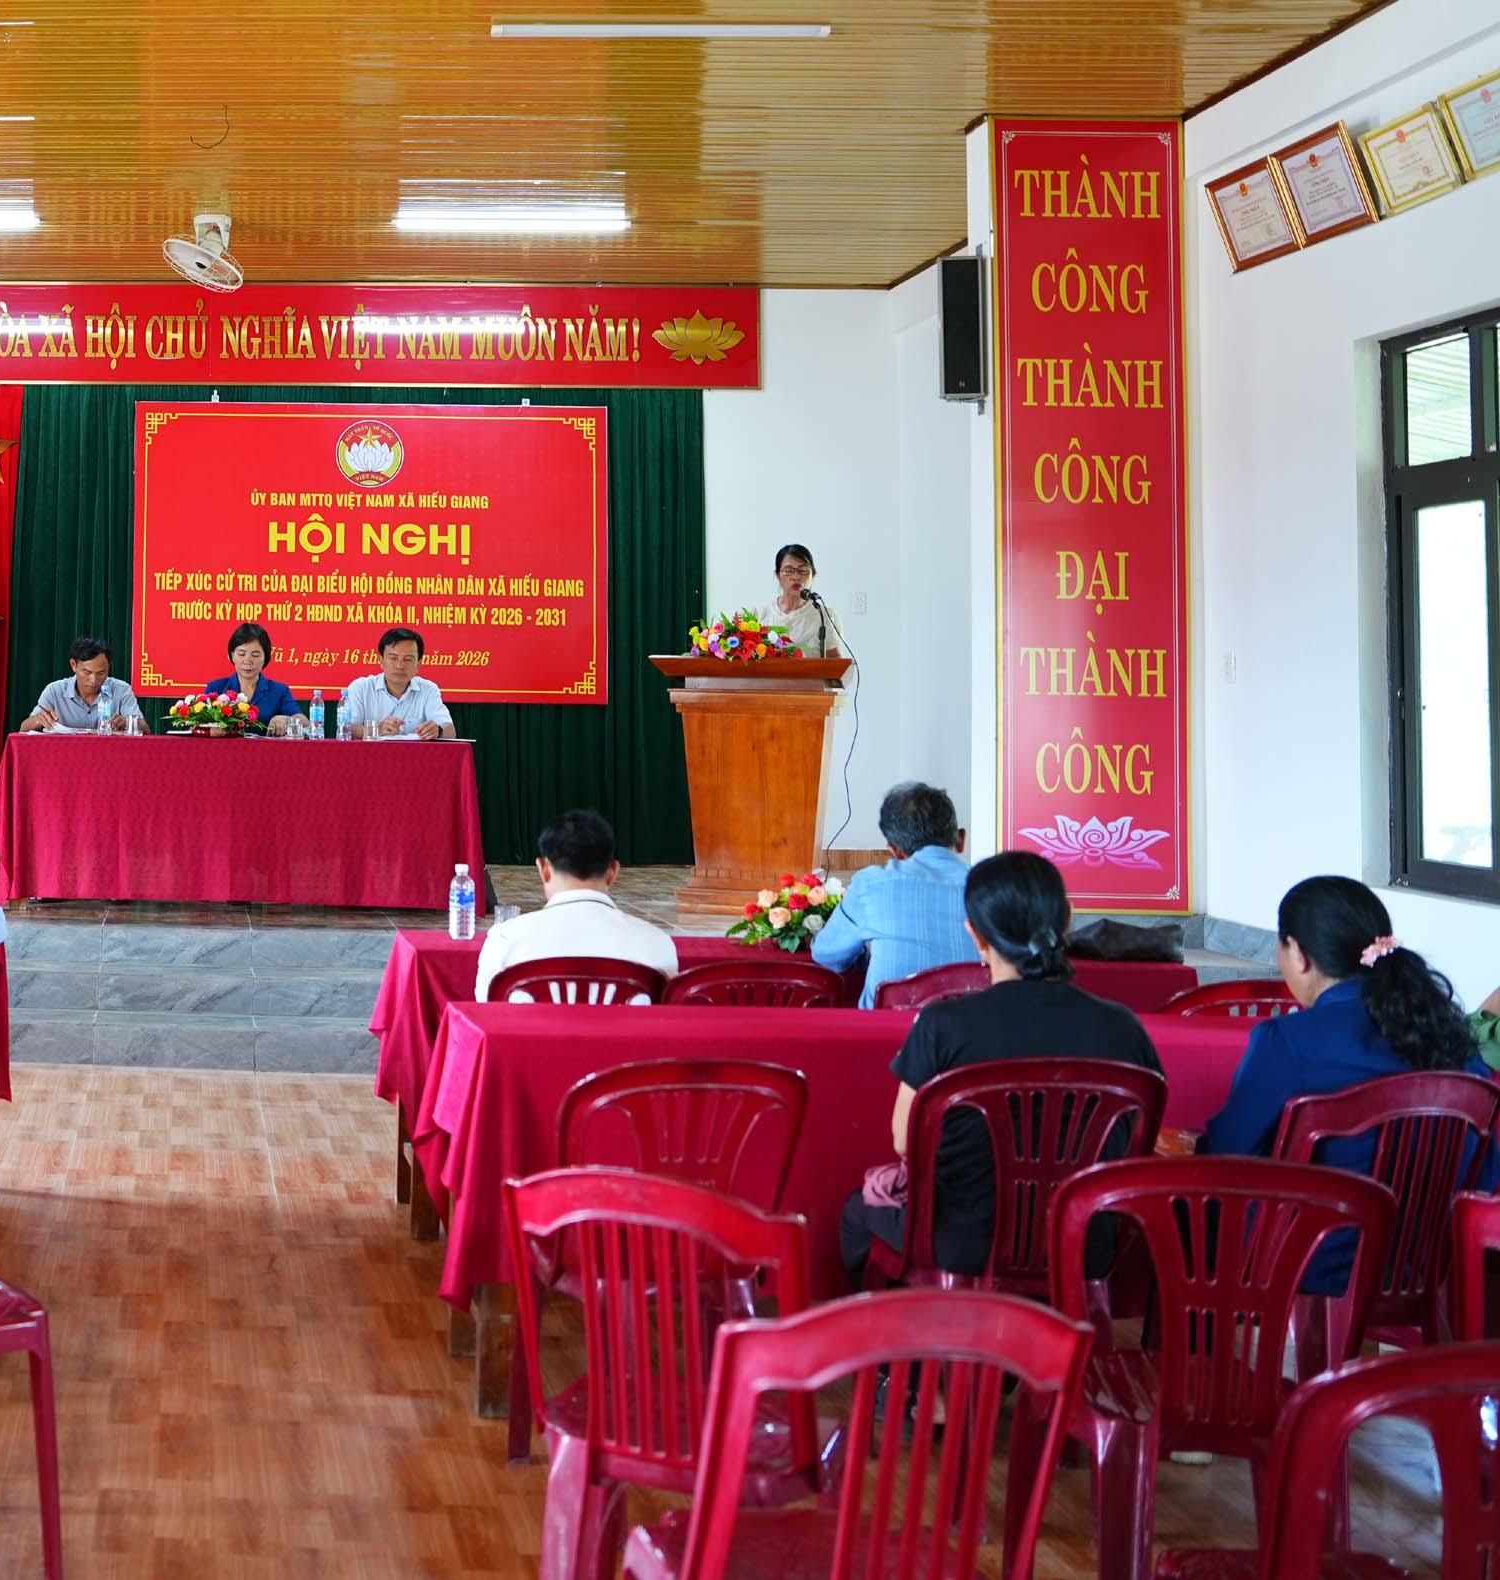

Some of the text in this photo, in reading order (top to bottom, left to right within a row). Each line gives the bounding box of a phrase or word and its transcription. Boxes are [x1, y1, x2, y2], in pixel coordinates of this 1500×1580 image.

[1014, 155, 1161, 218] THÀNH
[1032, 248, 1148, 313] CÔNG
[39, 303, 78, 358] XÃ
[84, 303, 135, 370] HỘI
[145, 298, 210, 359] CHỦ
[219, 306, 317, 361] NGHĨA
[318, 304, 387, 370] VIỆT
[396, 316, 461, 361] NAM
[470, 304, 556, 362] MUÔN
[1017, 342, 1164, 408] THÀNH
[250, 488, 489, 510] ỦY BAN MTTQ VIỆT NAM XÃ HIẾU GIANG
[1034, 437, 1152, 505] CÔNG
[268, 512, 471, 566] HỘI NGHỊ
[154, 567, 584, 598] TIẾP XÚC CỬ TRI CỦA ĐẠI BIỂU HỘI ĐỒNG NHÂN DÂN XÃ HIẾU GIANG
[170, 598, 212, 621] TRƯỚC
[215, 599, 232, 621] KỲ
[266, 599, 292, 622] THỨ
[294, 604, 303, 622] 2
[306, 604, 342, 622] HĐND
[346, 602, 364, 623] XÃ
[368, 602, 403, 624] KHÓA
[407, 606, 420, 626] II,
[424, 602, 466, 628] NHIỆM
[470, 603, 488, 625] KỲ
[491, 607, 522, 626] 2026
[535, 608, 567, 627] 2031
[1055, 549, 1130, 616] ĐẠI
[288, 648, 299, 666] 1,
[303, 648, 339, 667] ngày
[342, 648, 360, 664] 16
[421, 649, 490, 666] năm 2026
[1019, 630, 1167, 697] THÀNH
[1035, 726, 1154, 795] CÔNG
